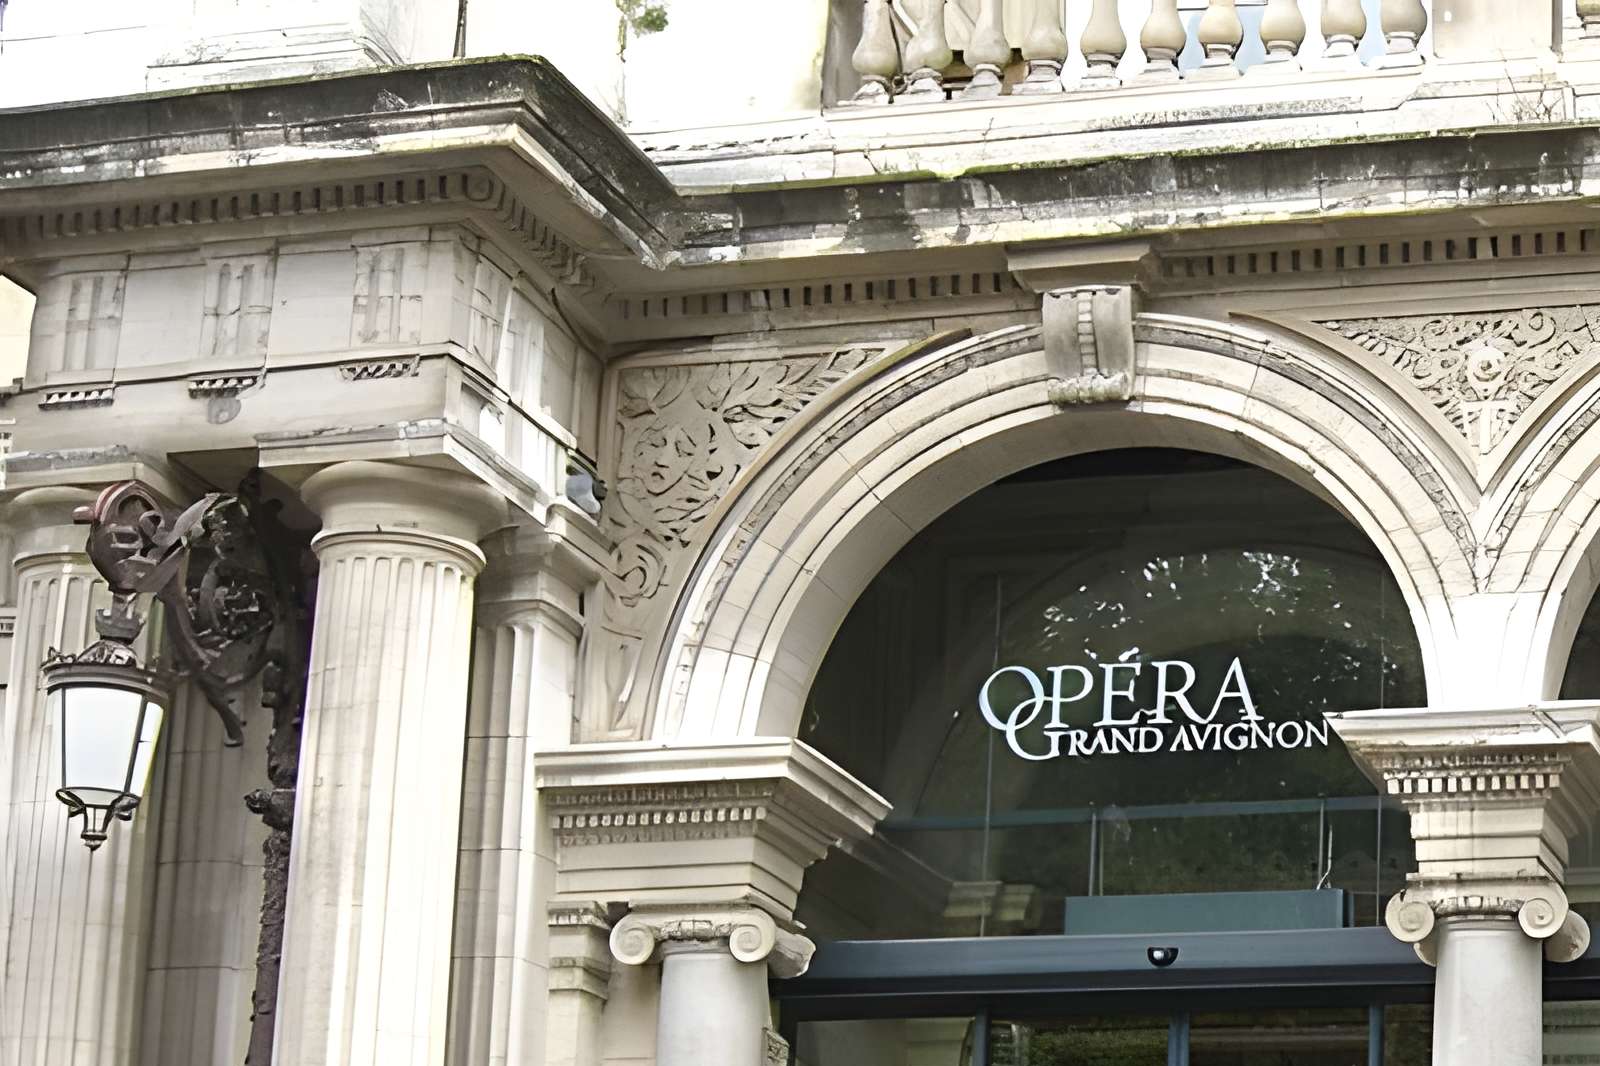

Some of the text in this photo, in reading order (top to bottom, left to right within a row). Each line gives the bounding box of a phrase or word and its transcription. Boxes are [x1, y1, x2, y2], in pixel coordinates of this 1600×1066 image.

[978, 646, 1265, 731] OPÉRA
[1005, 697, 1330, 761] GRAND AVIGNON
